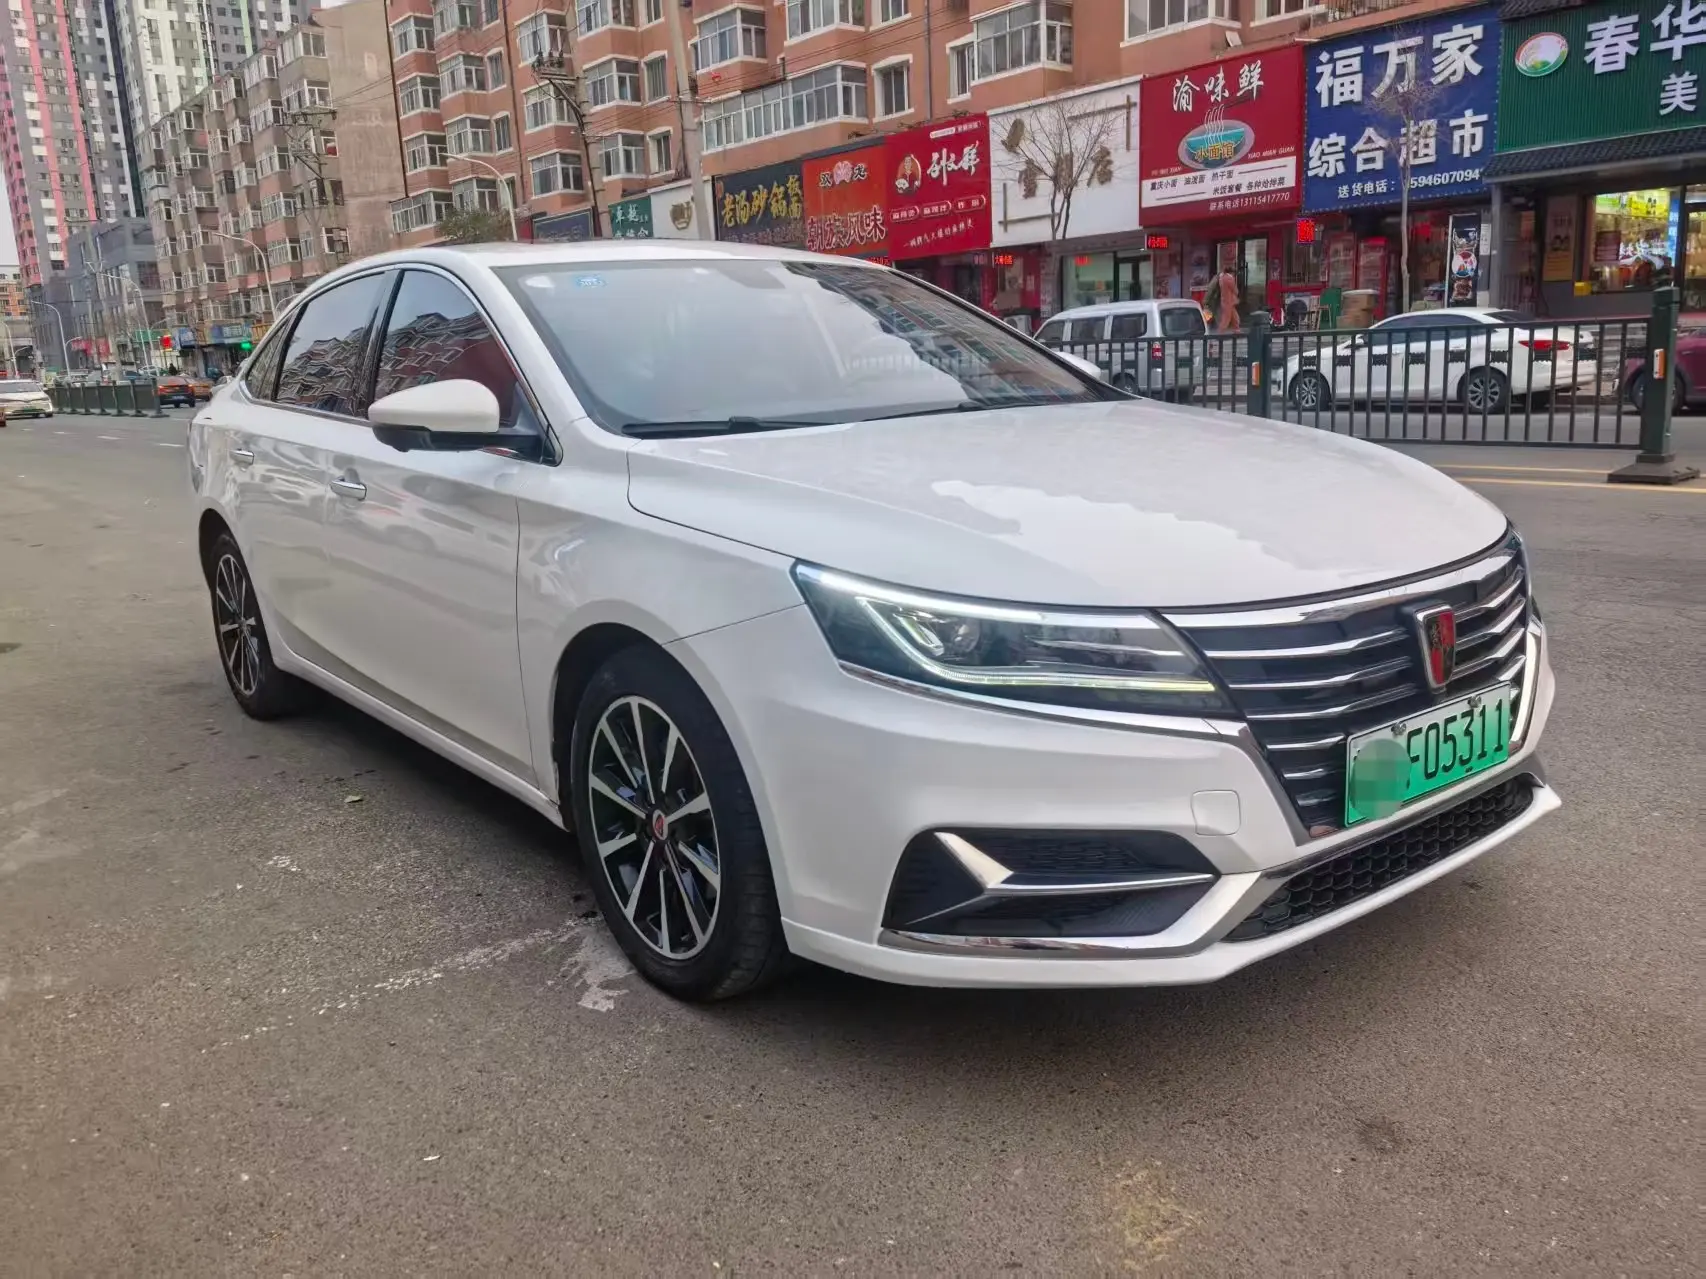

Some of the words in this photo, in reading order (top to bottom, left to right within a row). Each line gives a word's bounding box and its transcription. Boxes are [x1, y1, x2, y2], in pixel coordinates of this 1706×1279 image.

[1584, 0, 1706, 75] 春华
[1173, 60, 1264, 112] 渝味鲜
[1315, 24, 1484, 108] 福万家
[1659, 71, 1697, 116] 美
[1195, 142, 1234, 160] 小面馆
[1278, 146, 1295, 155] GUAN
[1308, 109, 1489, 178] 综合超市
[1150, 178, 1178, 191] 重庆小面
[1212, 183, 1243, 196] 米饭套餐
[1410, 168, 1482, 188] 594607094
[1407, 698, 1504, 789] F05311
